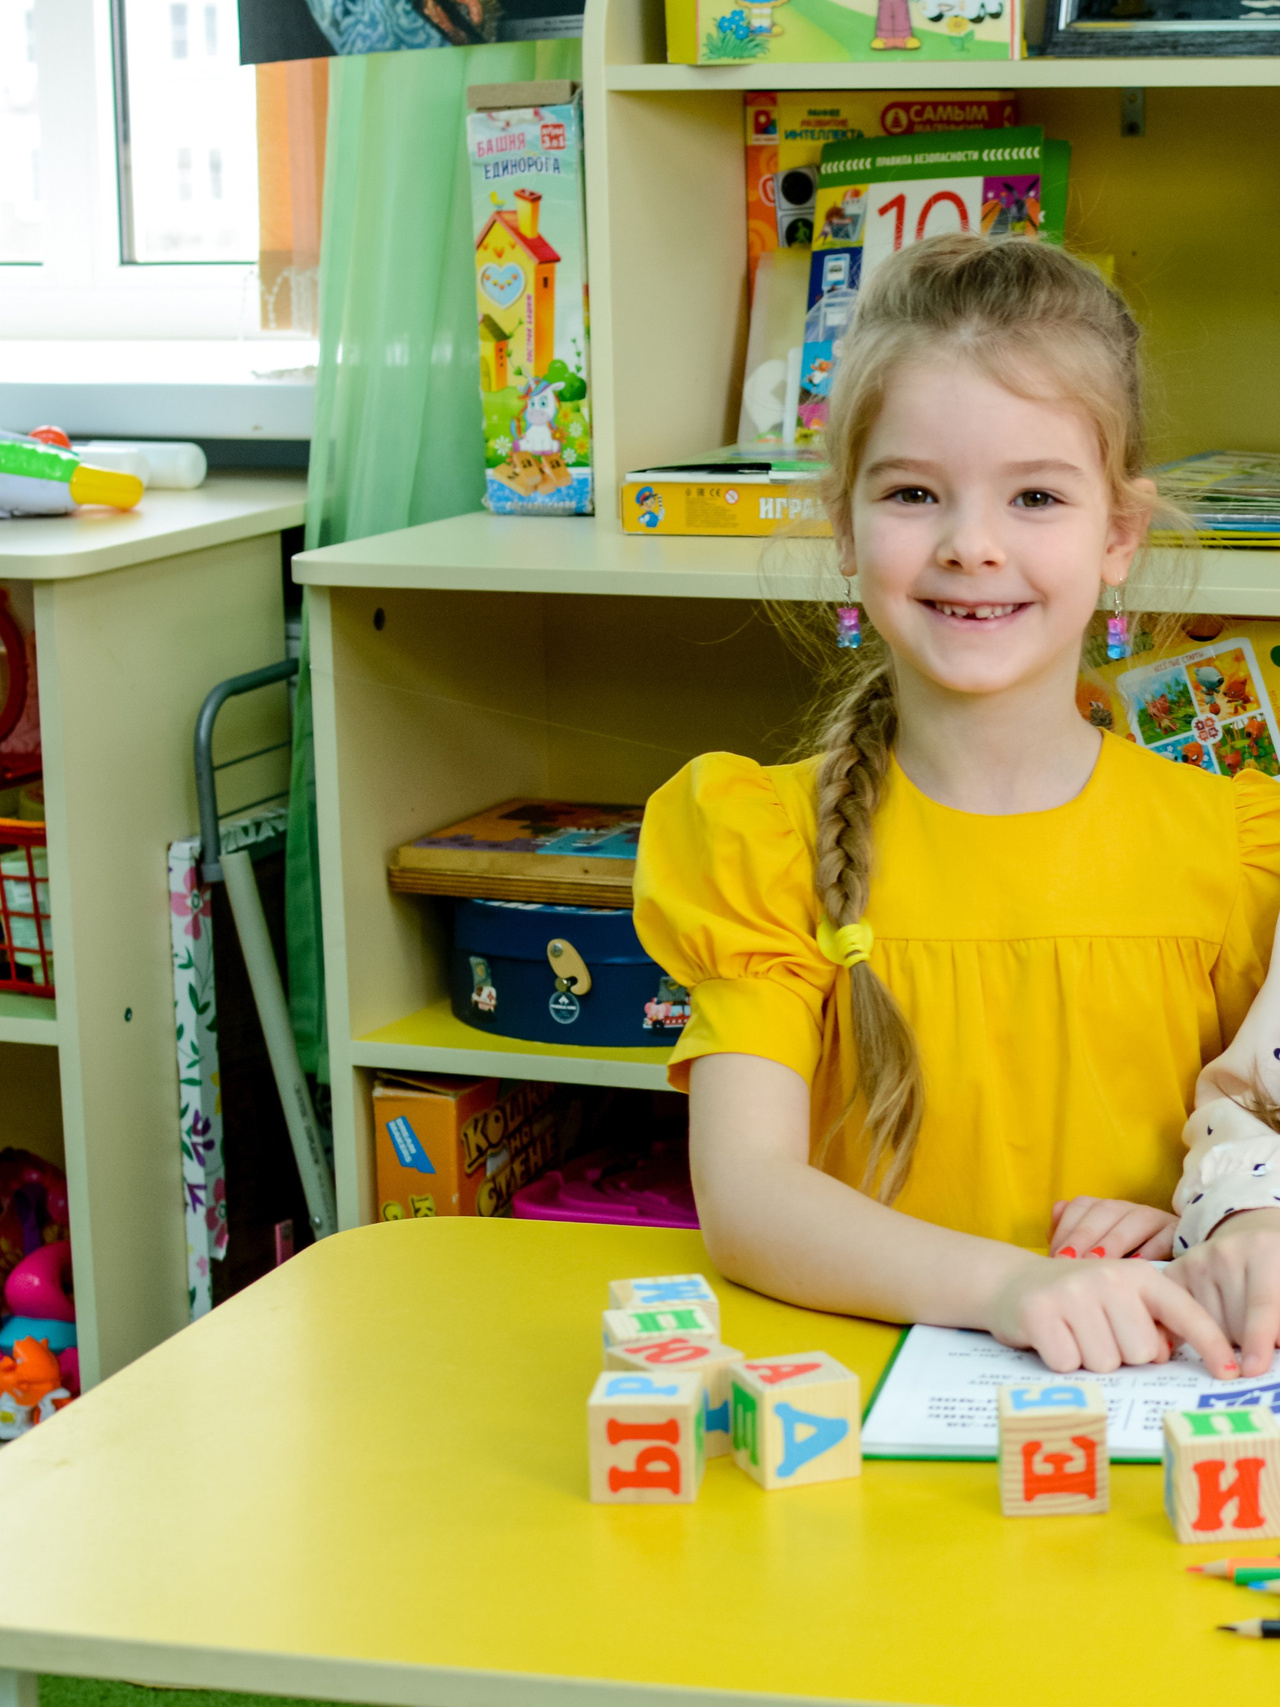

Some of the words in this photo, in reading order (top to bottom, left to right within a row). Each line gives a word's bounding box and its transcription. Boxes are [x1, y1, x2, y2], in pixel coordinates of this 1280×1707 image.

[909, 105, 989, 122] САМЫМ
[477, 133, 526, 158] БАШНЯ
[484, 157, 561, 180] ЕДИНОРОГА
[875, 155, 912, 167] ПРАВИЛА
[914, 150, 979, 164] БЕЗОПАСНОСТИ
[1192, 1457, 1266, 1531] И
